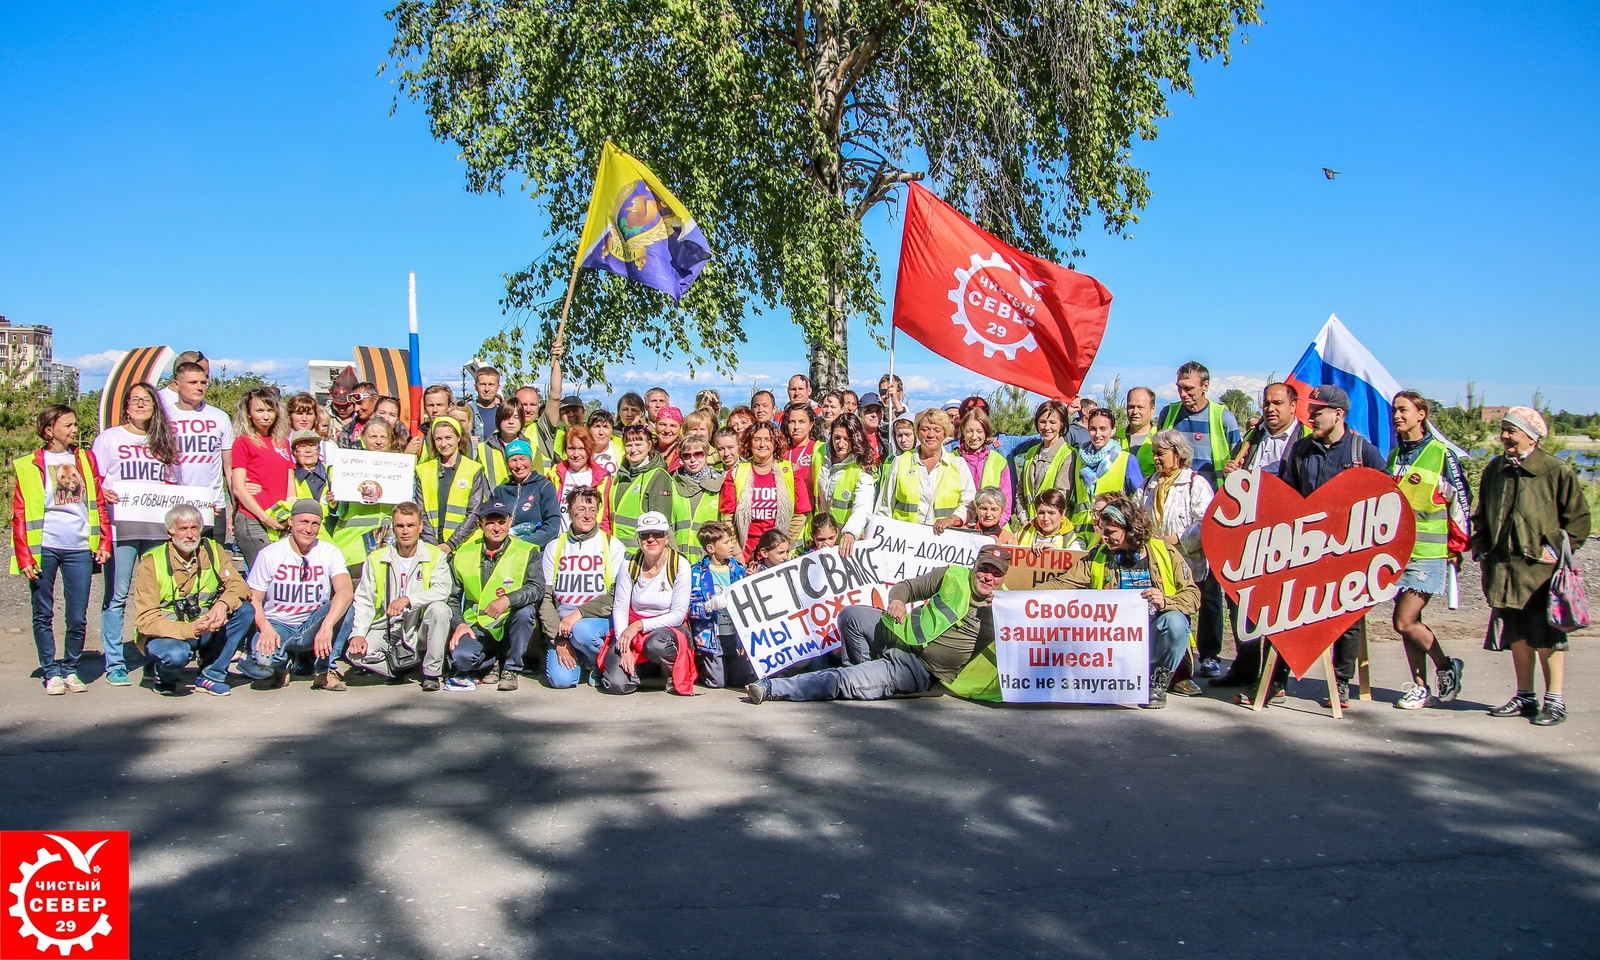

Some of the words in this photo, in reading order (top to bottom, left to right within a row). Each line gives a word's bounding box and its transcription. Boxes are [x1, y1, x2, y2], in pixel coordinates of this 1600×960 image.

[968, 290, 1035, 328] СЕВЕР
[985, 321, 1007, 338] 29
[170, 419, 217, 434] STOP
[177, 435, 217, 453] ИЕС
[1213, 468, 1261, 527] Я
[1221, 491, 1402, 582] ЛЮБЛЮ
[559, 555, 604, 571] STOP
[1003, 547, 1073, 570] ПРОТИВ
[274, 563, 325, 582] STOP
[554, 573, 605, 593] ШИЕС
[273, 582, 324, 604] ШИЕС
[730, 564, 802, 627] НЕТ
[1024, 598, 1119, 623] Свободу
[750, 621, 792, 657] МЫ
[788, 590, 862, 636] ТОЖЕ
[999, 626, 1143, 645] защитникам
[758, 640, 820, 673] ХОТИМ
[1028, 647, 1114, 667] Шиеса!
[1001, 673, 1031, 690] Нас
[1035, 676, 1056, 690] не
[1061, 675, 1142, 693] запугать!
